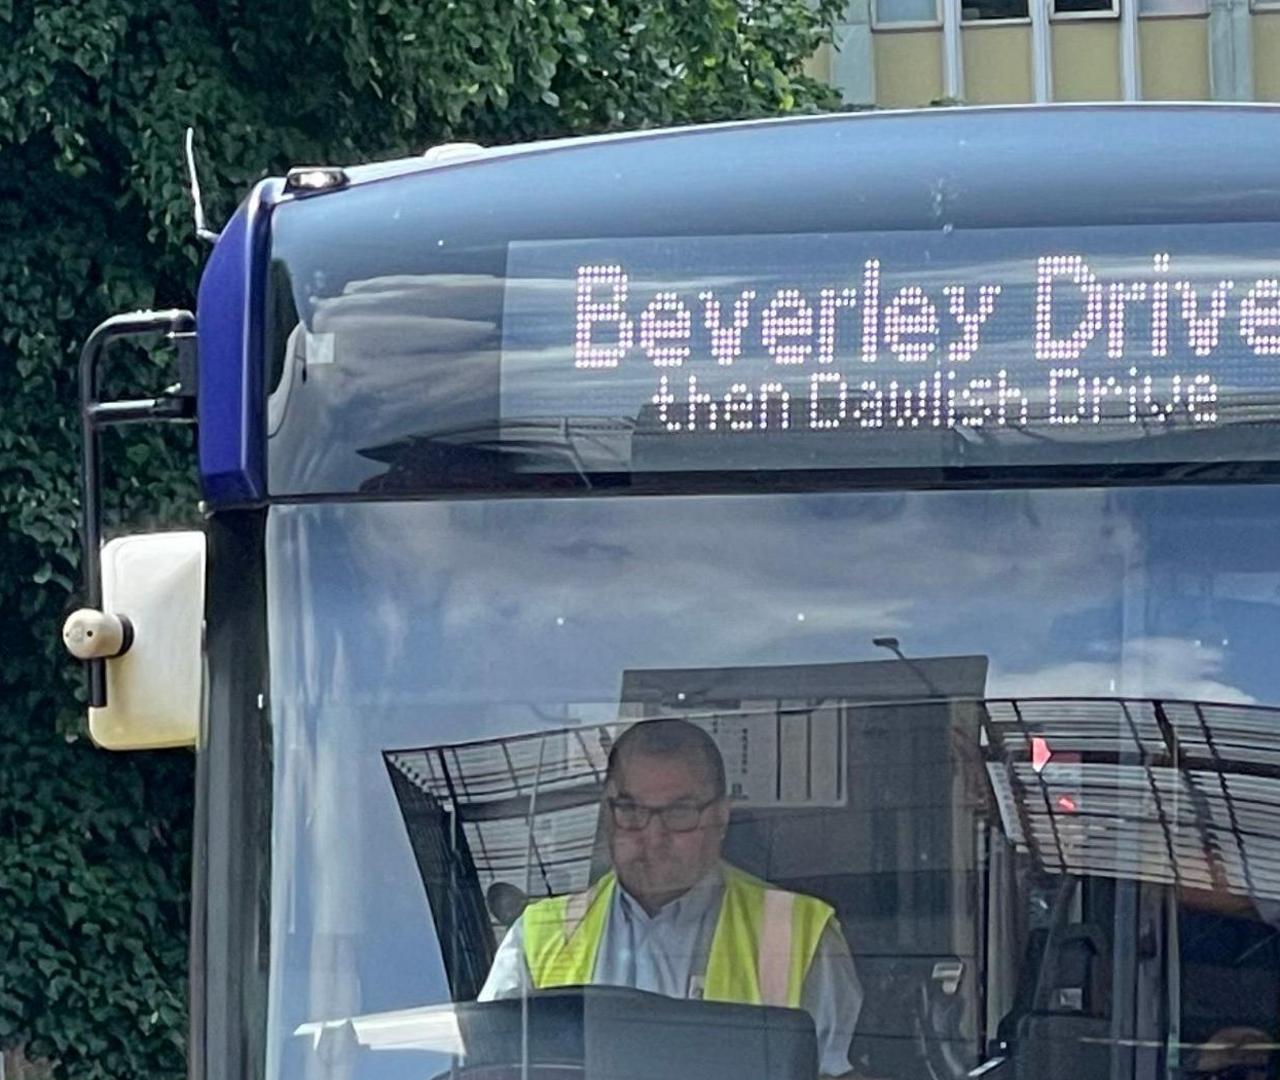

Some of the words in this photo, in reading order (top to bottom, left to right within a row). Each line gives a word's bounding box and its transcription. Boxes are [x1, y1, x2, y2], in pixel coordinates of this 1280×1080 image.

[575, 259, 1001, 368] Beverley
[653, 375, 790, 431] then
[810, 370, 1027, 428] Dawlish
[1049, 366, 1218, 424] Drive
